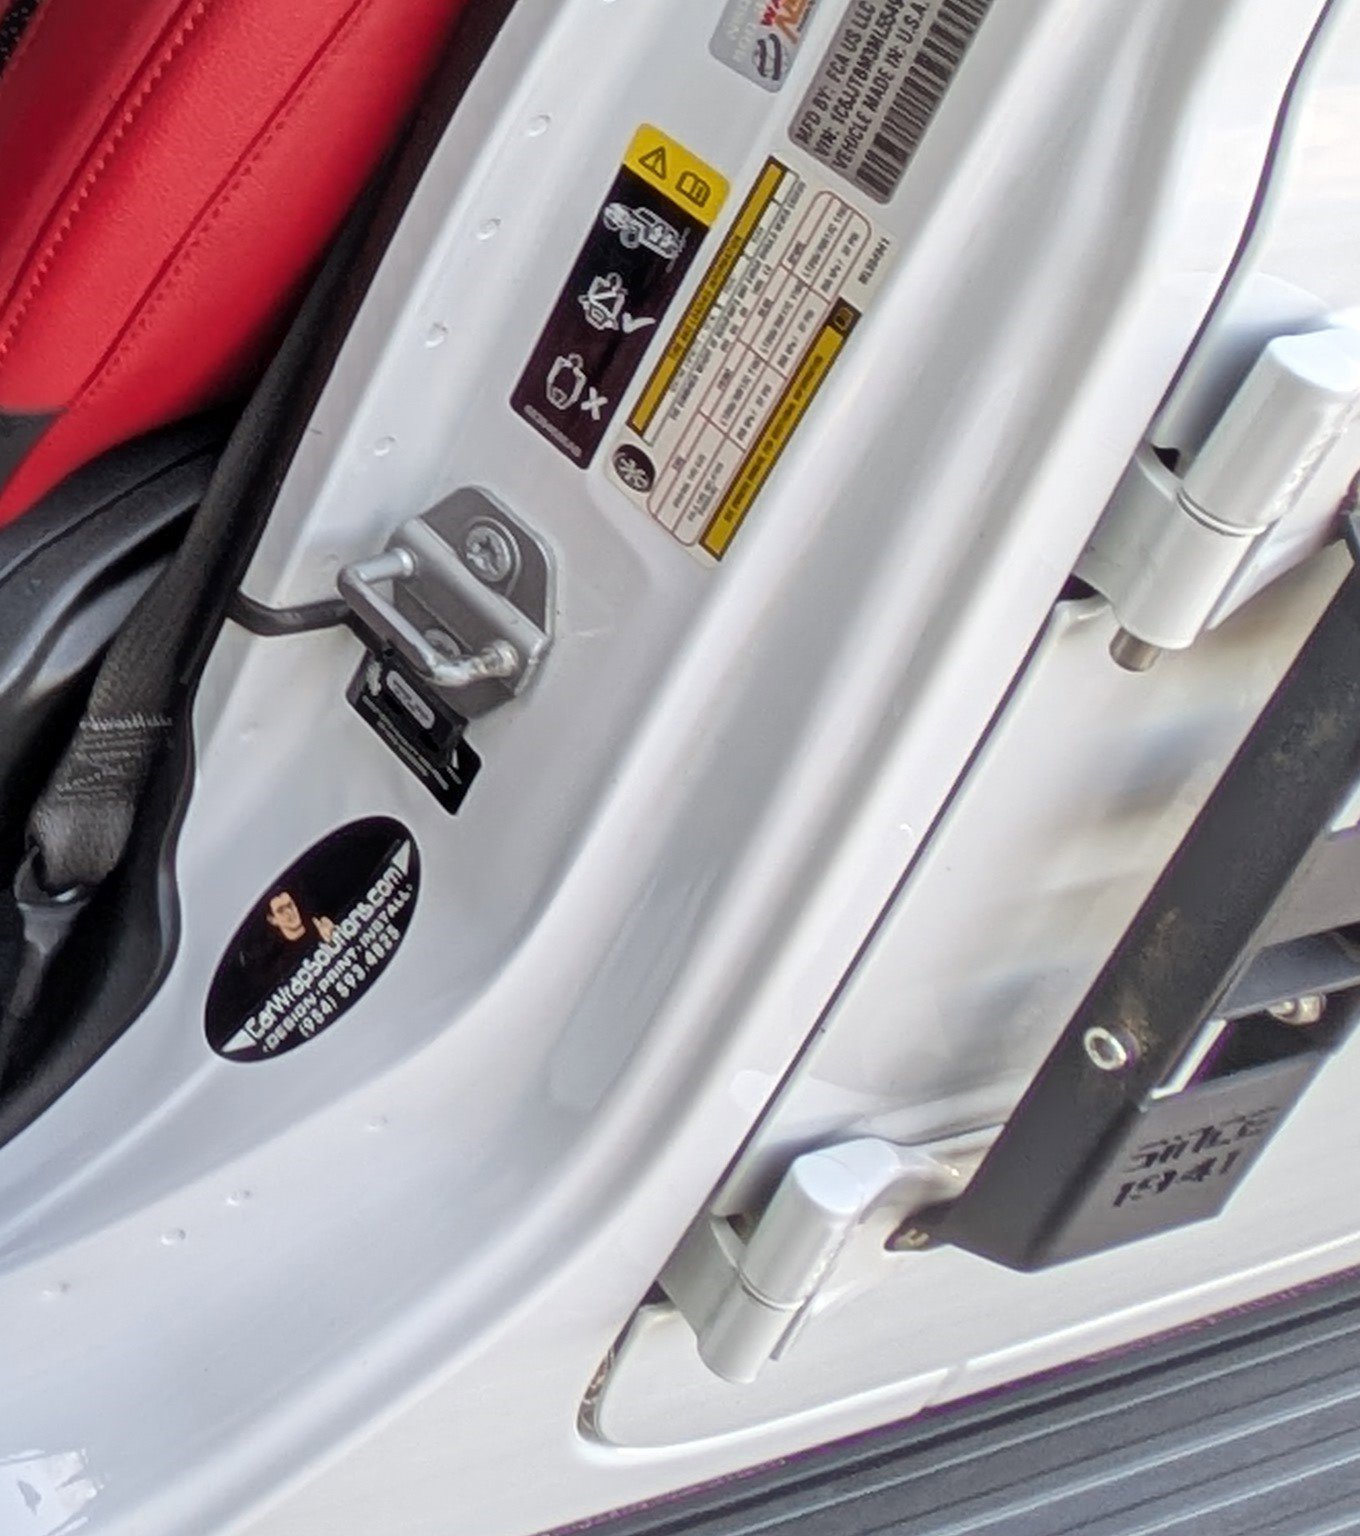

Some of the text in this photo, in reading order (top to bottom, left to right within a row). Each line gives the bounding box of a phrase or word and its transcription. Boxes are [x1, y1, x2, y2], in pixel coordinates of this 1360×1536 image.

[793, 108, 824, 146] MFD
[810, 82, 837, 112] BY:
[824, 51, 852, 84] FCA
[839, 27, 863, 53] US
[830, 110, 873, 171] VEHICLE
[860, 66, 895, 113] MADE
[882, 42, 907, 69] IN:
[812, 124, 841, 158] VIN:
[1113, 1150, 1242, 1208] 1941
